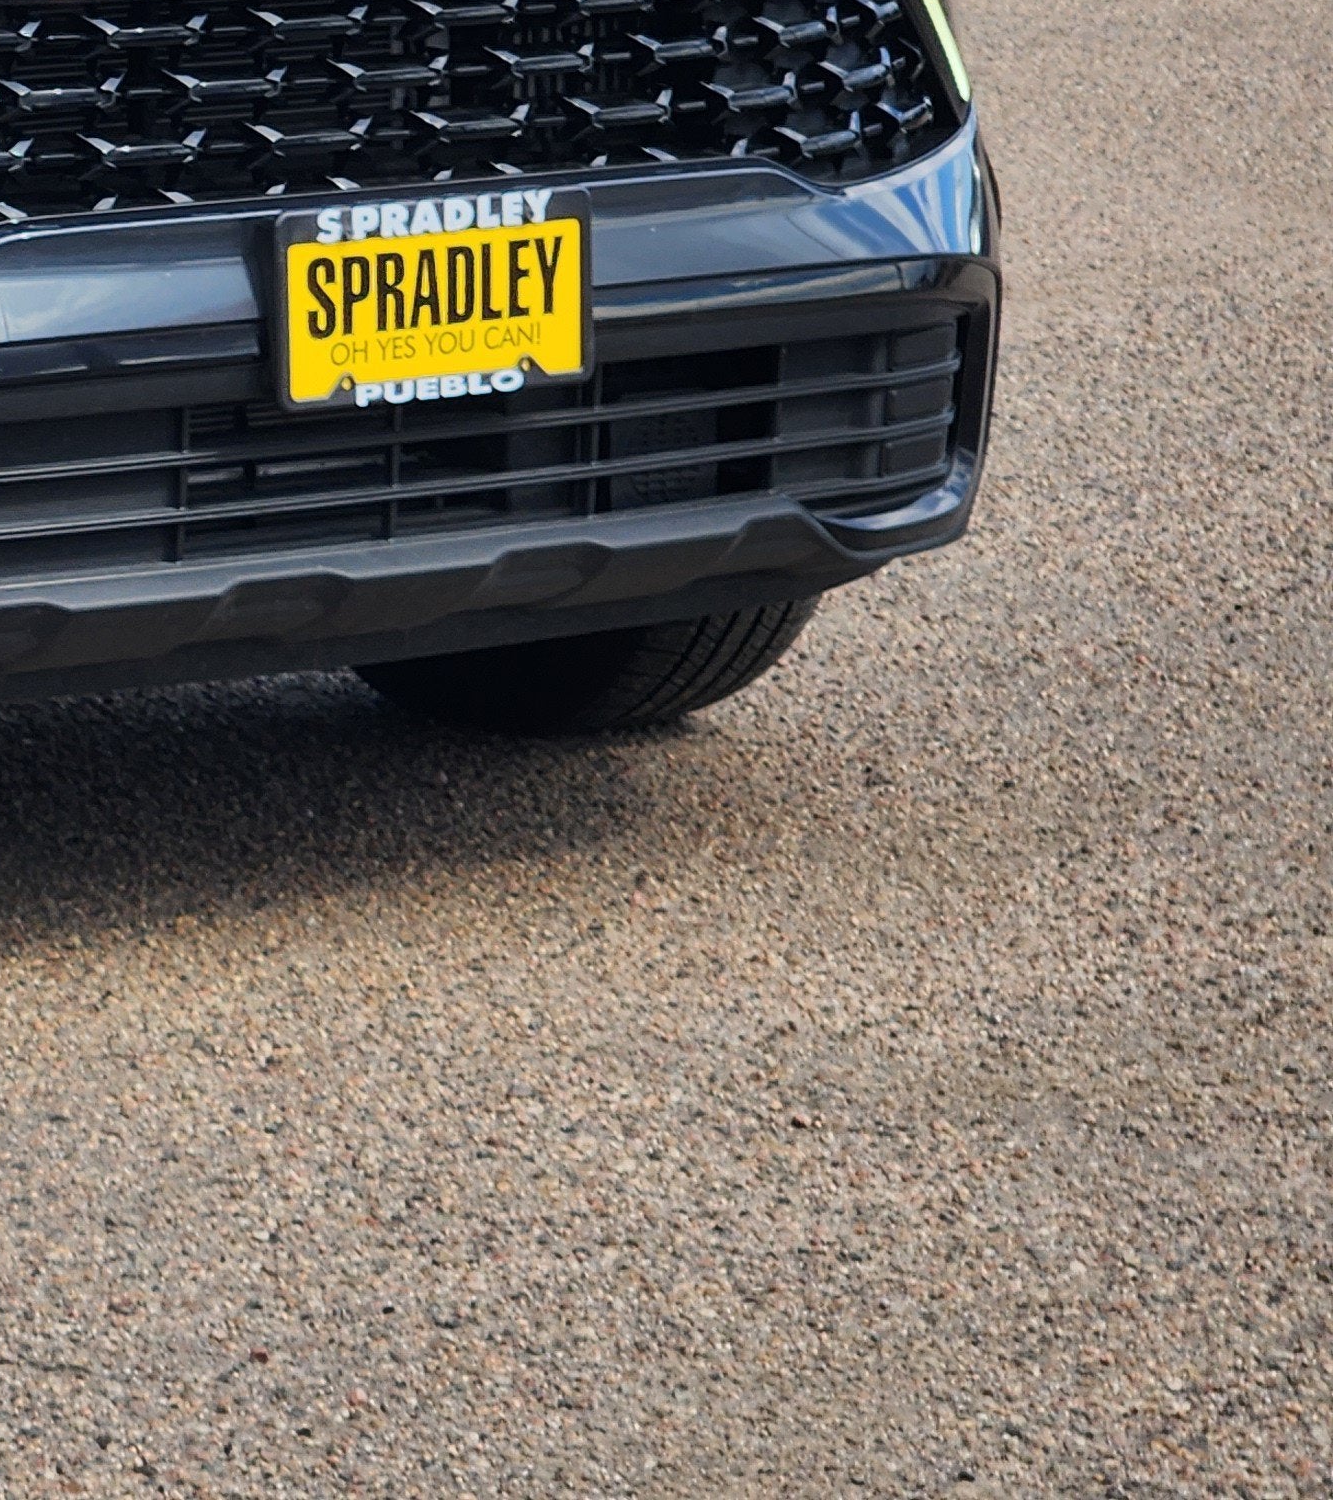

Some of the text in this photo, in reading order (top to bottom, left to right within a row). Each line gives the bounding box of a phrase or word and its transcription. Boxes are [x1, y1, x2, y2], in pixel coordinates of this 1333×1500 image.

[316, 188, 552, 244] SPRADLEY
[307, 235, 563, 340] SPRADLEY
[330, 321, 542, 366] OH YES YOU CAN!
[354, 368, 525, 408] PUEBLO
